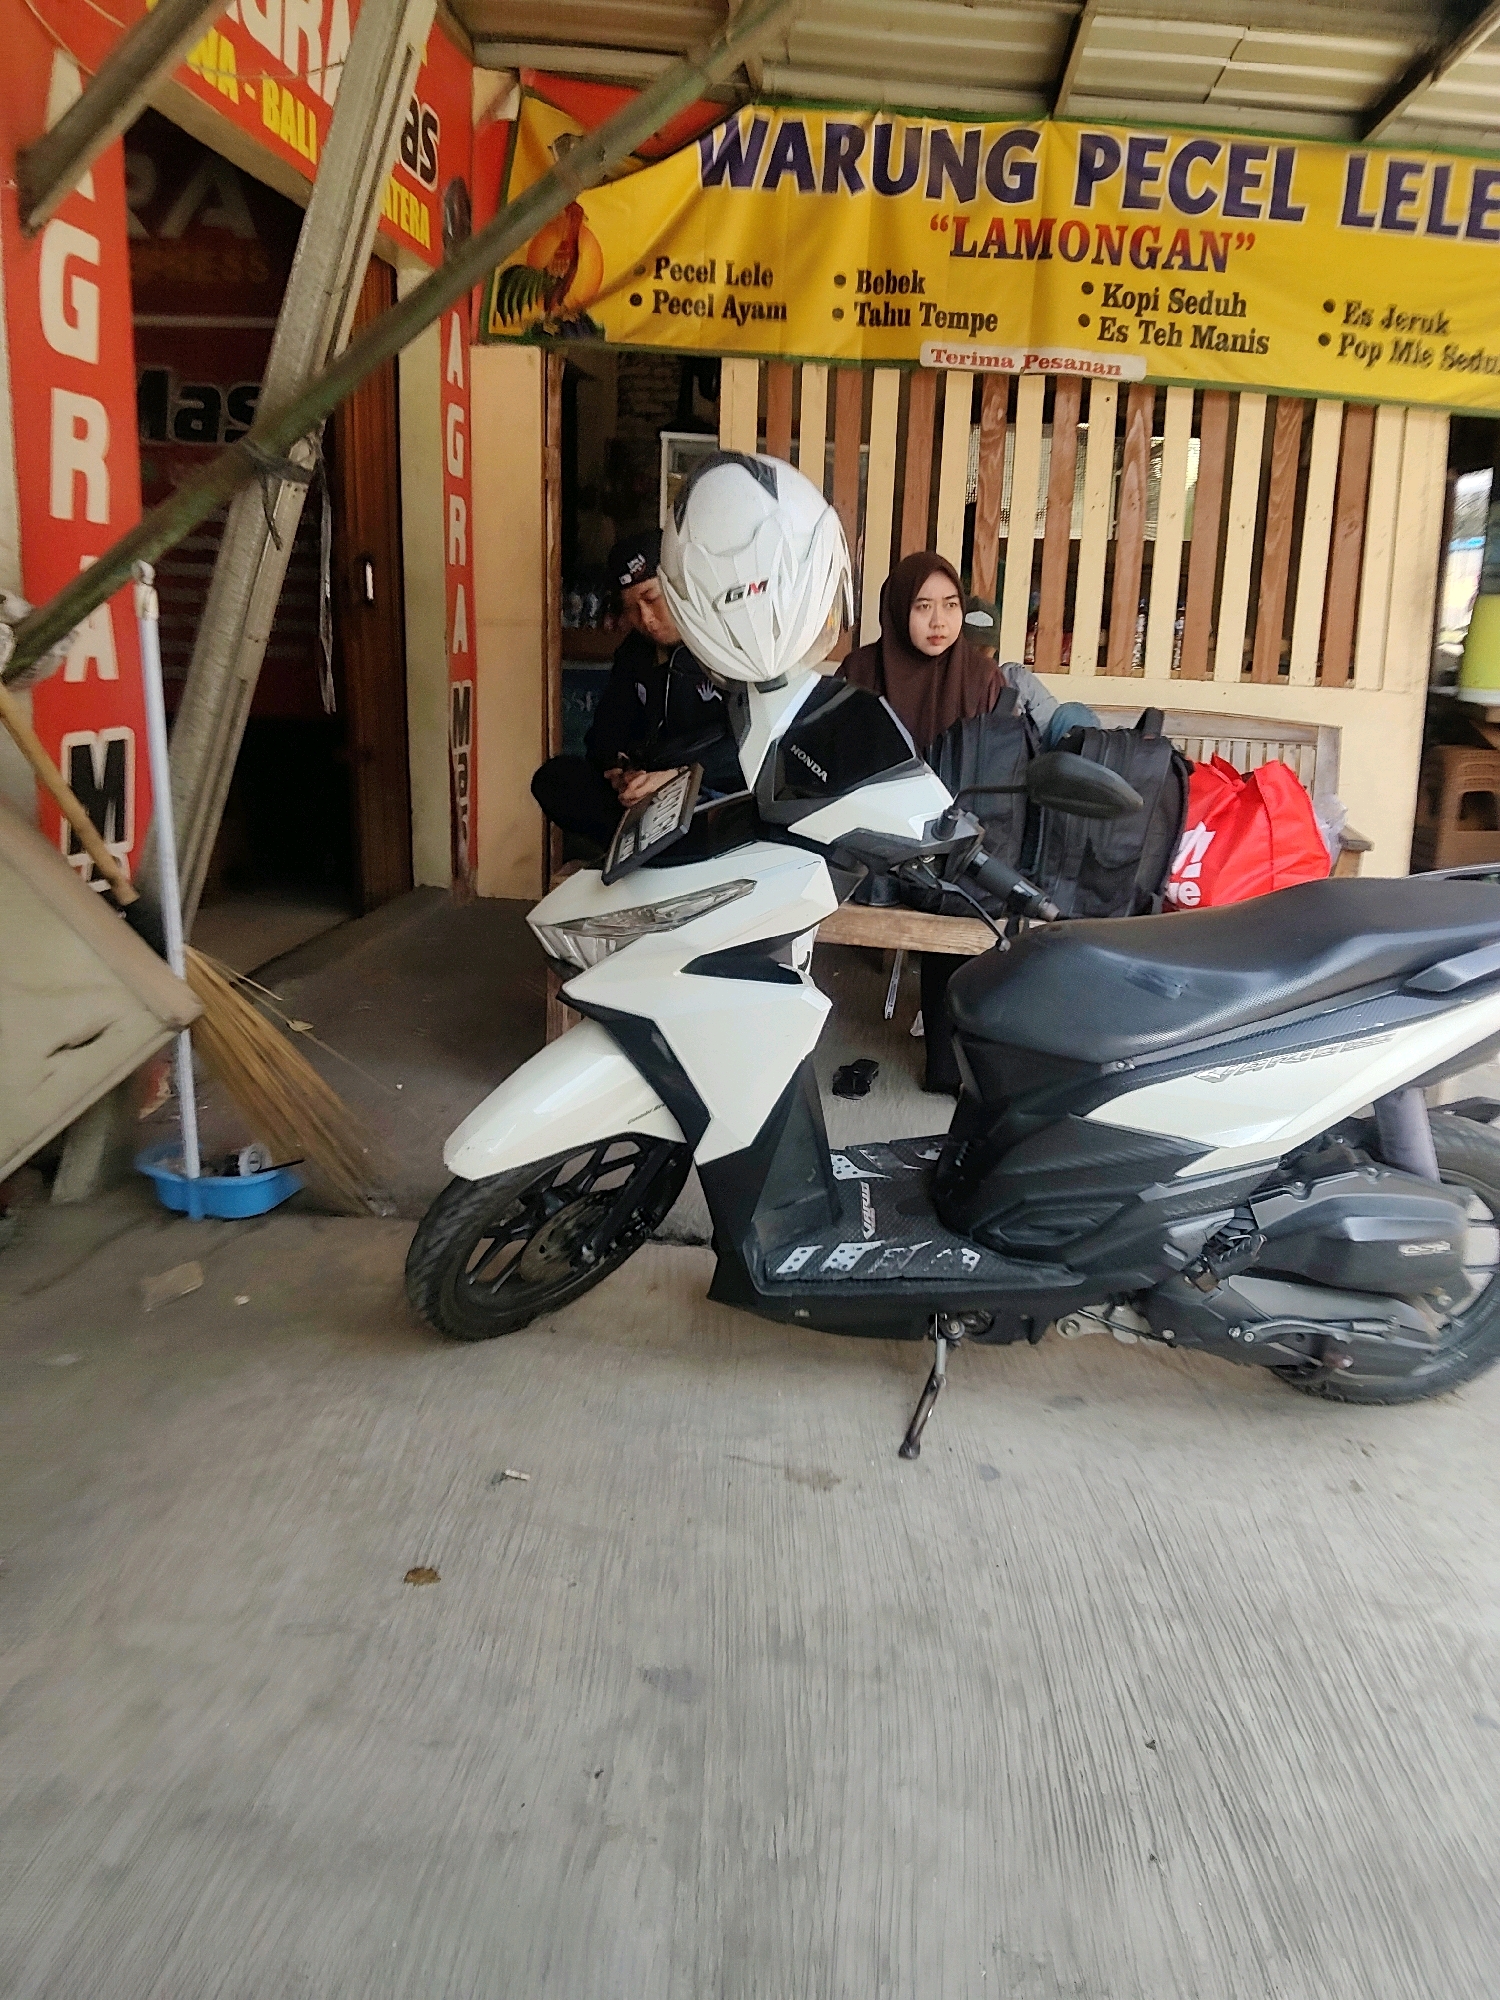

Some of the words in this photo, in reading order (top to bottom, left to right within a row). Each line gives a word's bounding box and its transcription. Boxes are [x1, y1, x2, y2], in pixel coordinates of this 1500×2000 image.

[262, 75, 317, 166] BALI
[698, 110, 1043, 205] WARUNG
[1072, 132, 1306, 222] PECEL
[1339, 155, 1500, 240] LELE
[653, 255, 716, 285] Pecel
[725, 259, 774, 288] Lele
[855, 268, 926, 295] Bebek
[652, 289, 714, 318] Pecel
[721, 294, 787, 327] Ayam
[1101, 282, 1160, 317] Kopi
[1167, 287, 1247, 317] Seduh
[1341, 299, 1374, 328] Es
[1379, 303, 1451, 336] Jeruk
[853, 301, 911, 327] Tahu
[919, 302, 998, 338] Tempe
[1097, 316, 1130, 343] Es
[1138, 320, 1183, 347] Teh
[1189, 325, 1270, 354] Manis
[930, 348, 1015, 369] Terima
[1022, 353, 1122, 377] Pesanan
[1336, 332, 1384, 370] Pop
[1387, 336, 1434, 368] Mie
[1438, 342, 1500, 375] Sedu
[446, 311, 468, 654] AGRA
[724, 578, 769, 604] GM
[790, 744, 828, 783] HONDA
